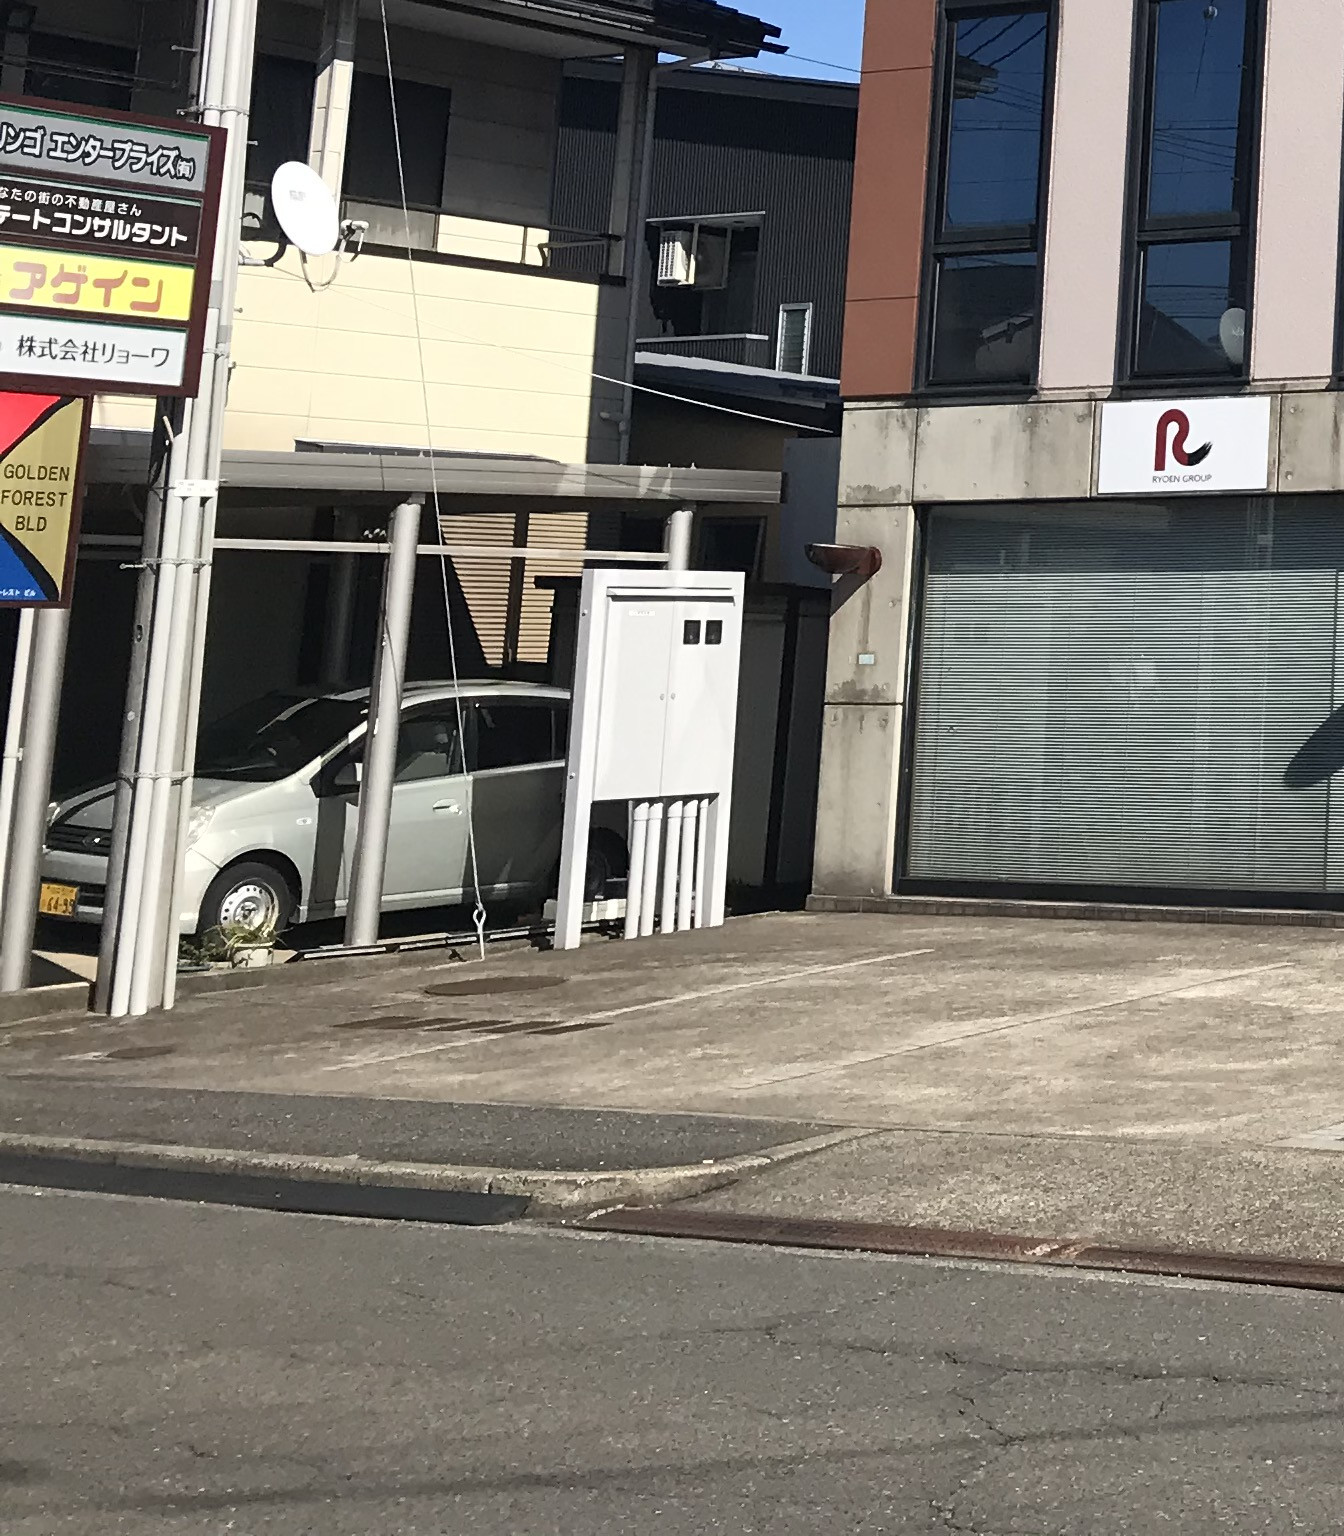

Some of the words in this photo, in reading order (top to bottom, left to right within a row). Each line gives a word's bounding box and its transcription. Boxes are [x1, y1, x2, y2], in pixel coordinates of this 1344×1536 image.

[9, 261, 163, 313] アゲイン
[16, 335, 169, 367] 株式会社リョーワ
[4, 464, 70, 482] GOLDEN
[1183, 474, 1213, 483] GROUP
[1, 490, 67, 507] FOREST
[15, 515, 47, 532] BLD
